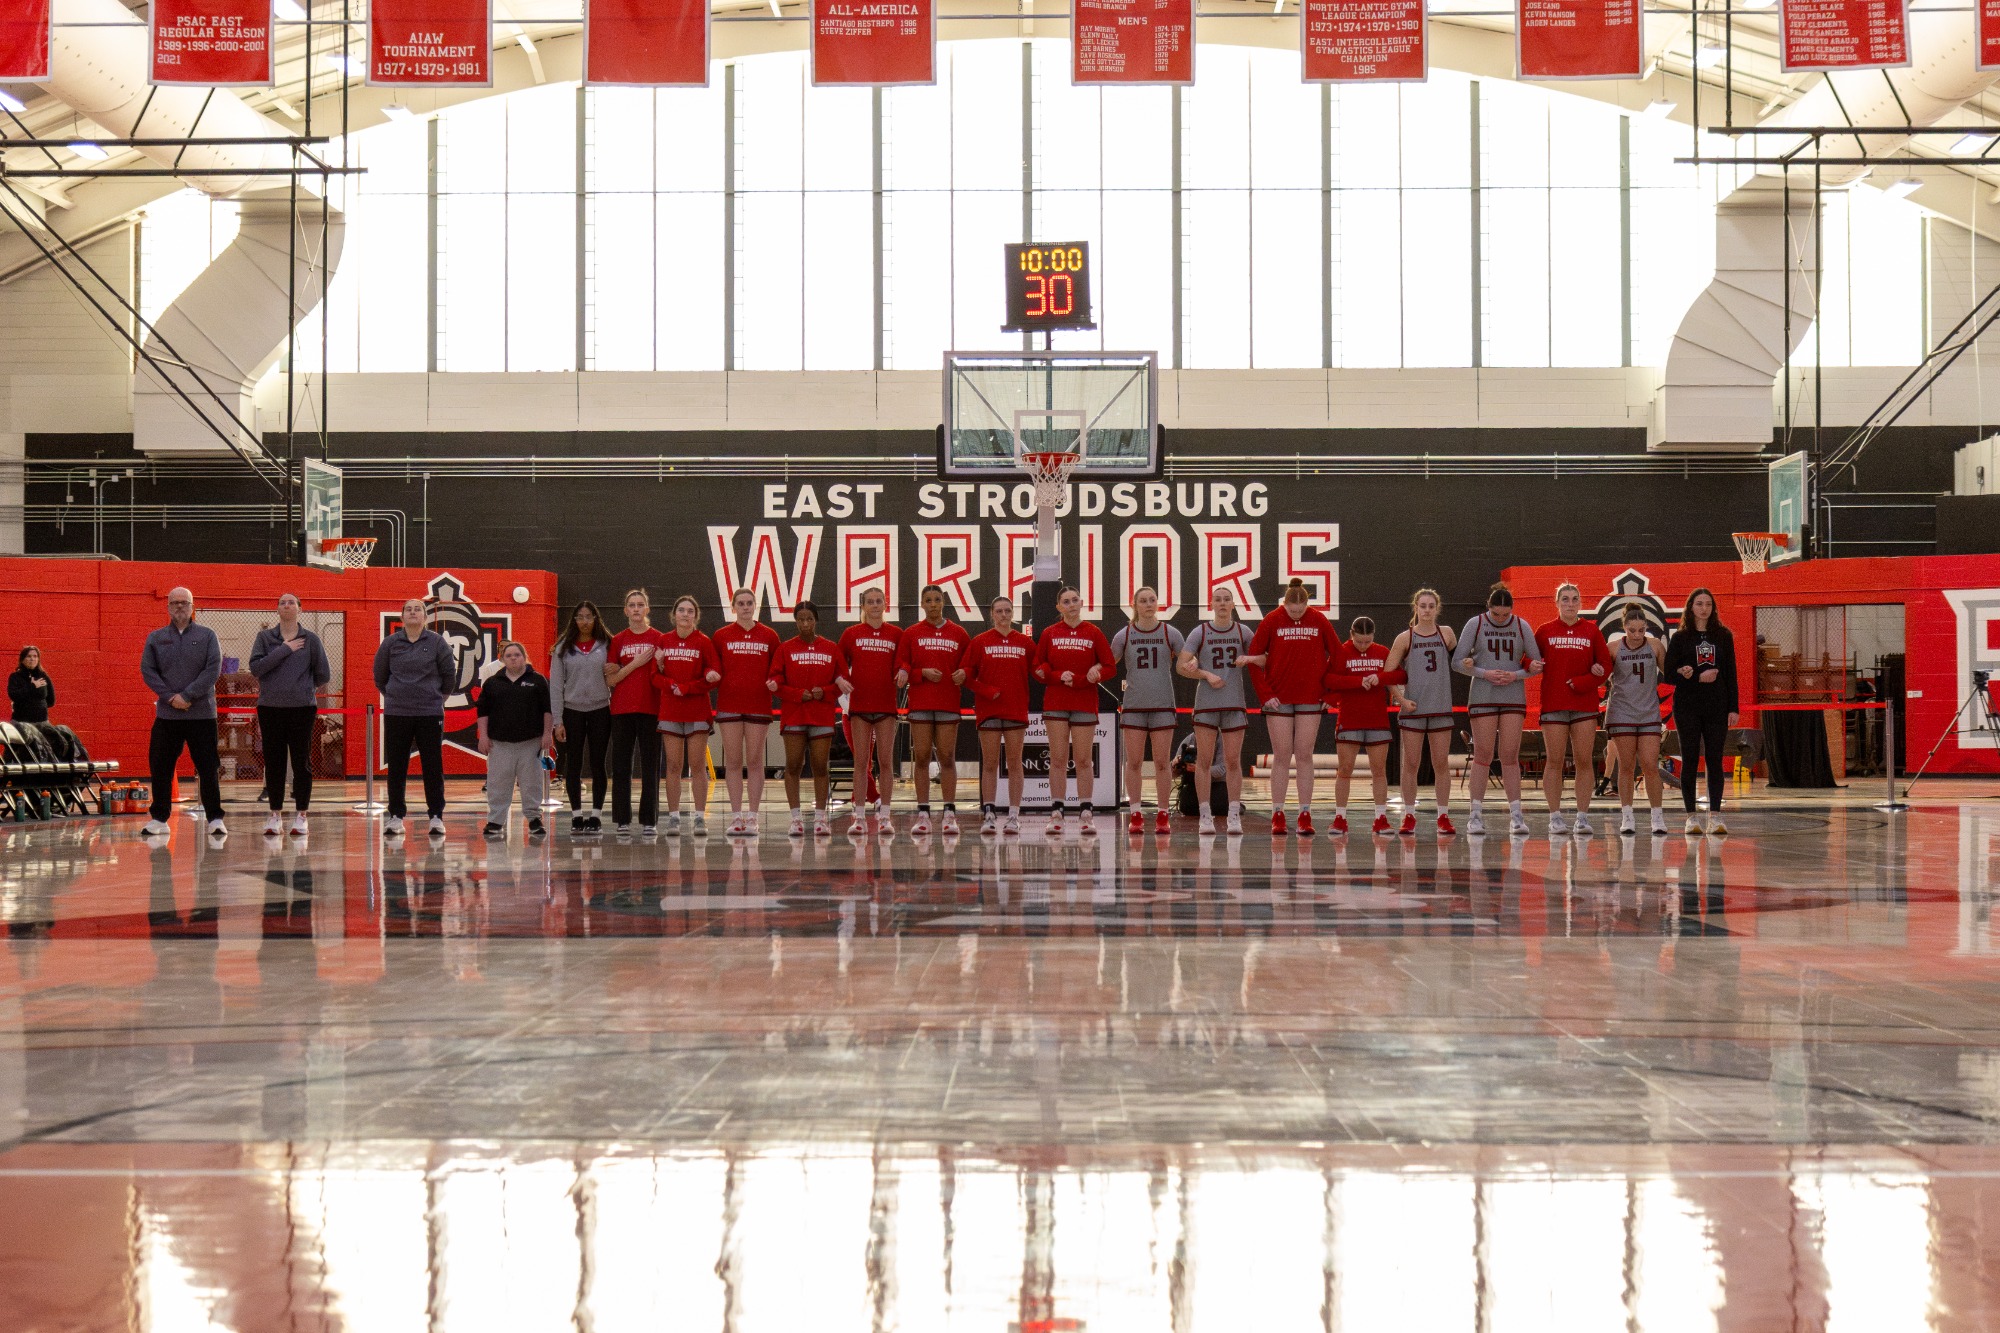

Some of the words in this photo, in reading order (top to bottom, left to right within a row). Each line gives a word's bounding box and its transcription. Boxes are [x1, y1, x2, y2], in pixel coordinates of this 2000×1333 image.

[829, 5, 918, 15] ALL-AMERICA
[1310, 3, 1339, 11] NORTH
[1342, 3, 1388, 11] ATLANTIC
[1390, 2, 1419, 10] GYMN.
[1360, 11, 1406, 19] CHAMPION
[177, 17, 206, 26] PSAC
[212, 17, 242, 26] EAST
[1118, 17, 1148, 25] MEN'S
[159, 28, 215, 38] REGULAR
[220, 28, 265, 38] SEASON
[409, 33, 444, 44] AIAW
[1337, 37, 1420, 46] INTERCOLLEGIATE
[382, 46, 476, 57] TOURNAMENT
[1376, 45, 1411, 53] LEAGUE
[157, 54, 181, 64] 2021
[1353, 65, 1376, 74] 1985
[1021, 248, 1082, 272] 10:00
[1026, 274, 1072, 316] 30
[763, 484, 884, 518] EAST
[918, 482, 1268, 518] STROUDSBURG
[707, 523, 1340, 622] WARRIORS
[1277, 628, 1318, 636] WARRIORS
[727, 642, 768, 652] WARRIORS
[856, 638, 896, 650] WARRIORS
[918, 638, 959, 650] WARRIORS
[1052, 638, 1093, 649] WARRIORS
[1548, 637, 1591, 647] WARRIORS
[984, 646, 1026, 656] WARRIORS
[1488, 639, 1514, 661] 44
[790, 652, 832, 663] WARRIORS
[1137, 647, 1158, 669] 21
[1212, 646, 1238, 669] 23
[1424, 650, 1437, 672] 3
[1346, 659, 1384, 668] WARRIORS
[1633, 662, 1644, 683] 4
